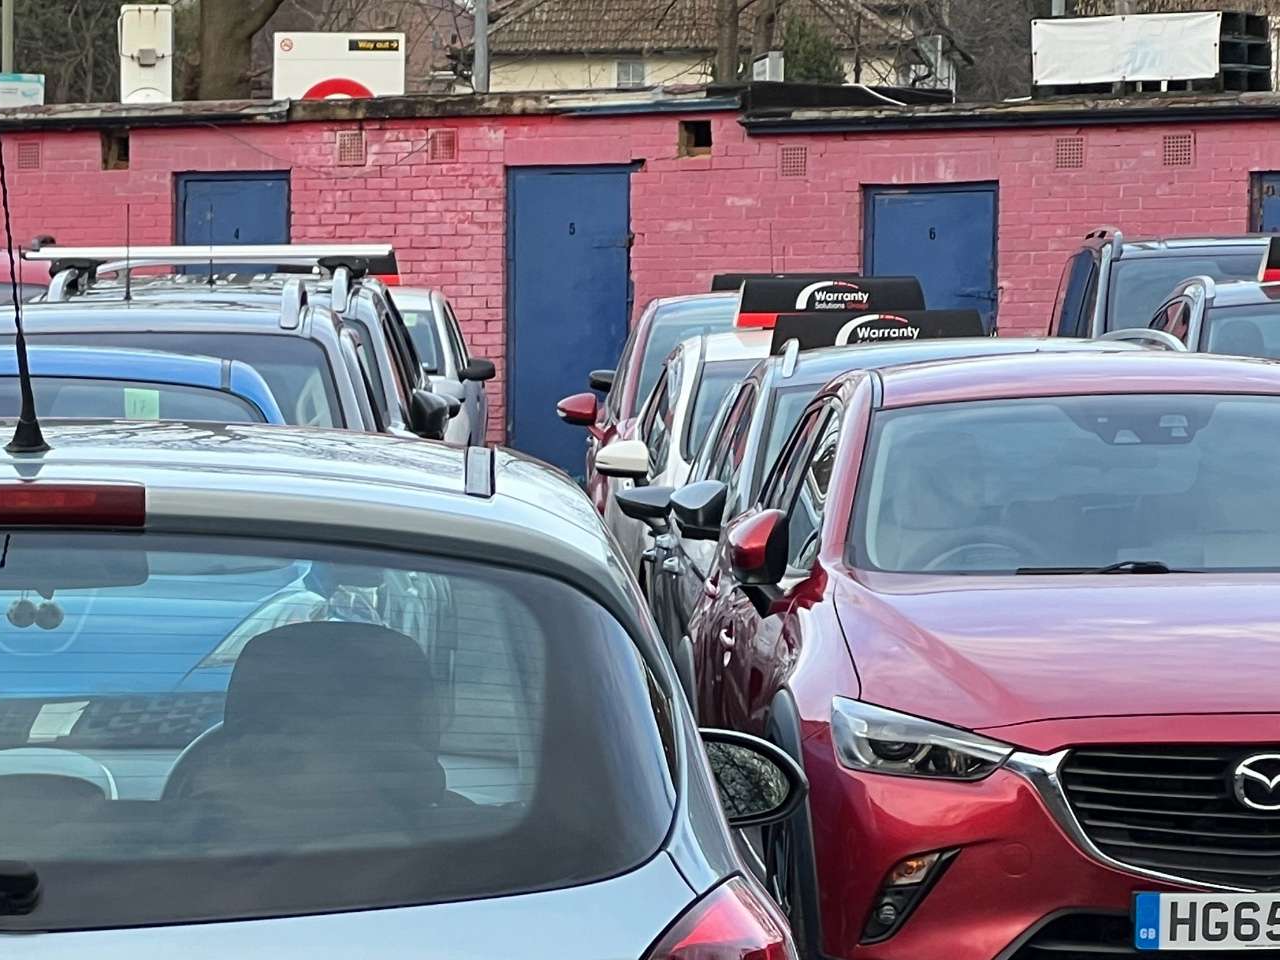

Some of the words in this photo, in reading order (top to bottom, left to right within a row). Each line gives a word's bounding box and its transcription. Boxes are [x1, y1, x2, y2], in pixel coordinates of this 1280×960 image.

[358, 41, 374, 49] Way
[569, 222, 576, 236] 5
[929, 226, 936, 240] 6
[814, 290, 869, 304] Warranty
[815, 302, 845, 310] Solutions
[856, 326, 920, 340] Warranty
[1139, 928, 1156, 940] GB
